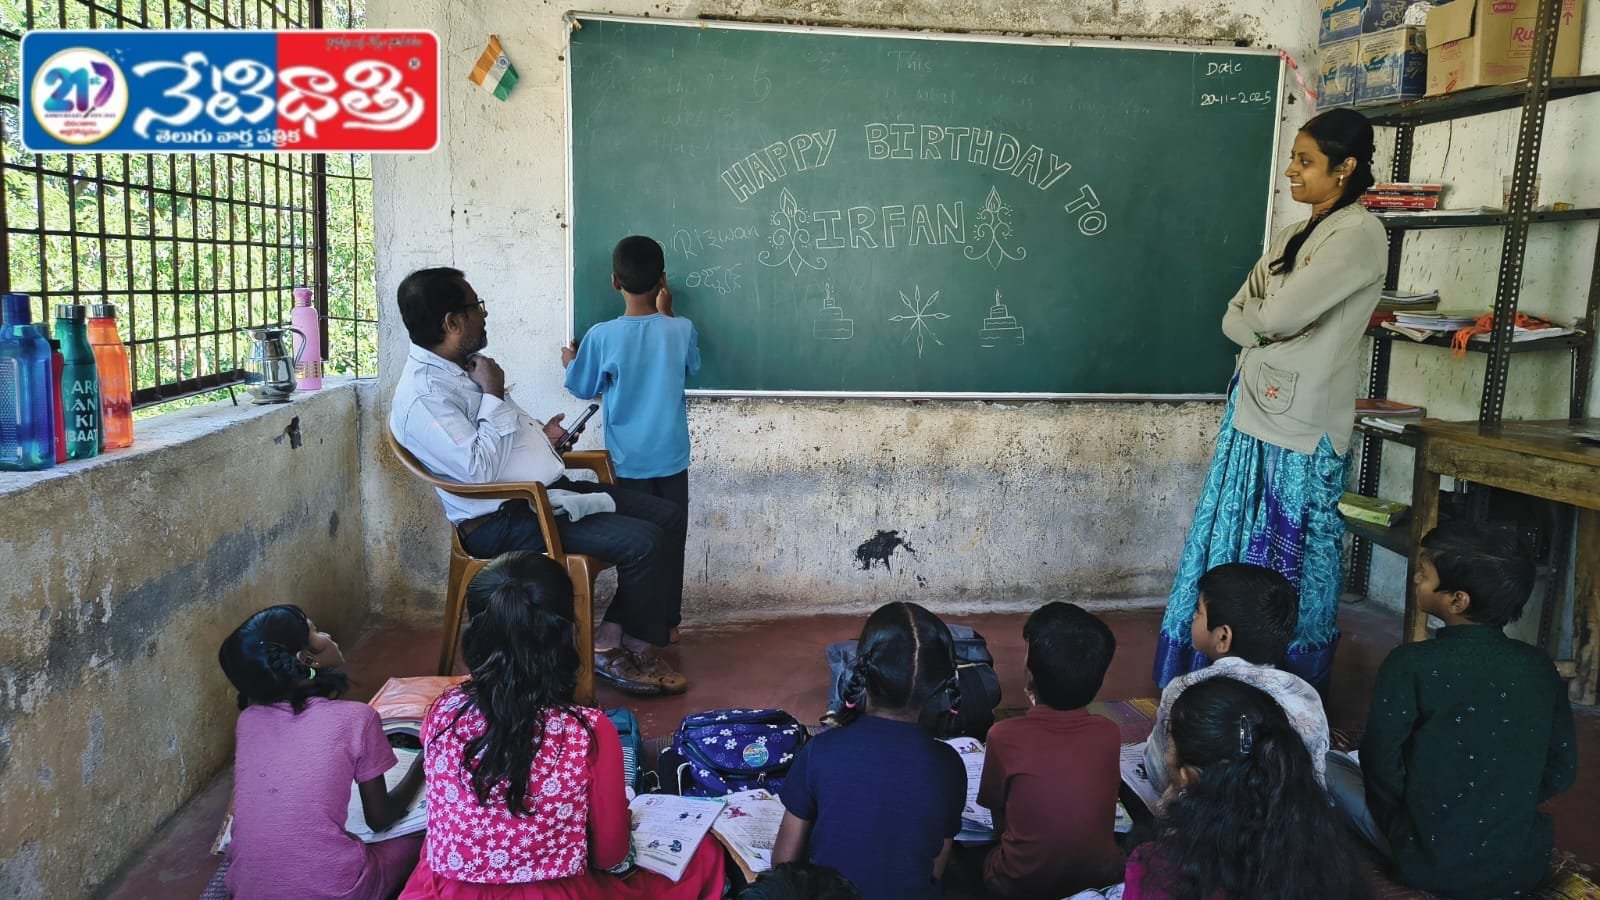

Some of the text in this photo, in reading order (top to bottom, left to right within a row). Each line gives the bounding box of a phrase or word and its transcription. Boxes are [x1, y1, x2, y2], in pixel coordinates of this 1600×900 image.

[1205, 60, 1242, 76] Date
[1200, 91, 1272, 106] 20-11-2025
[720, 122, 1107, 236] HAPPY BIRTHDAY TO
[813, 201, 966, 249] IRFAN
[75, 414, 93, 428] KI
